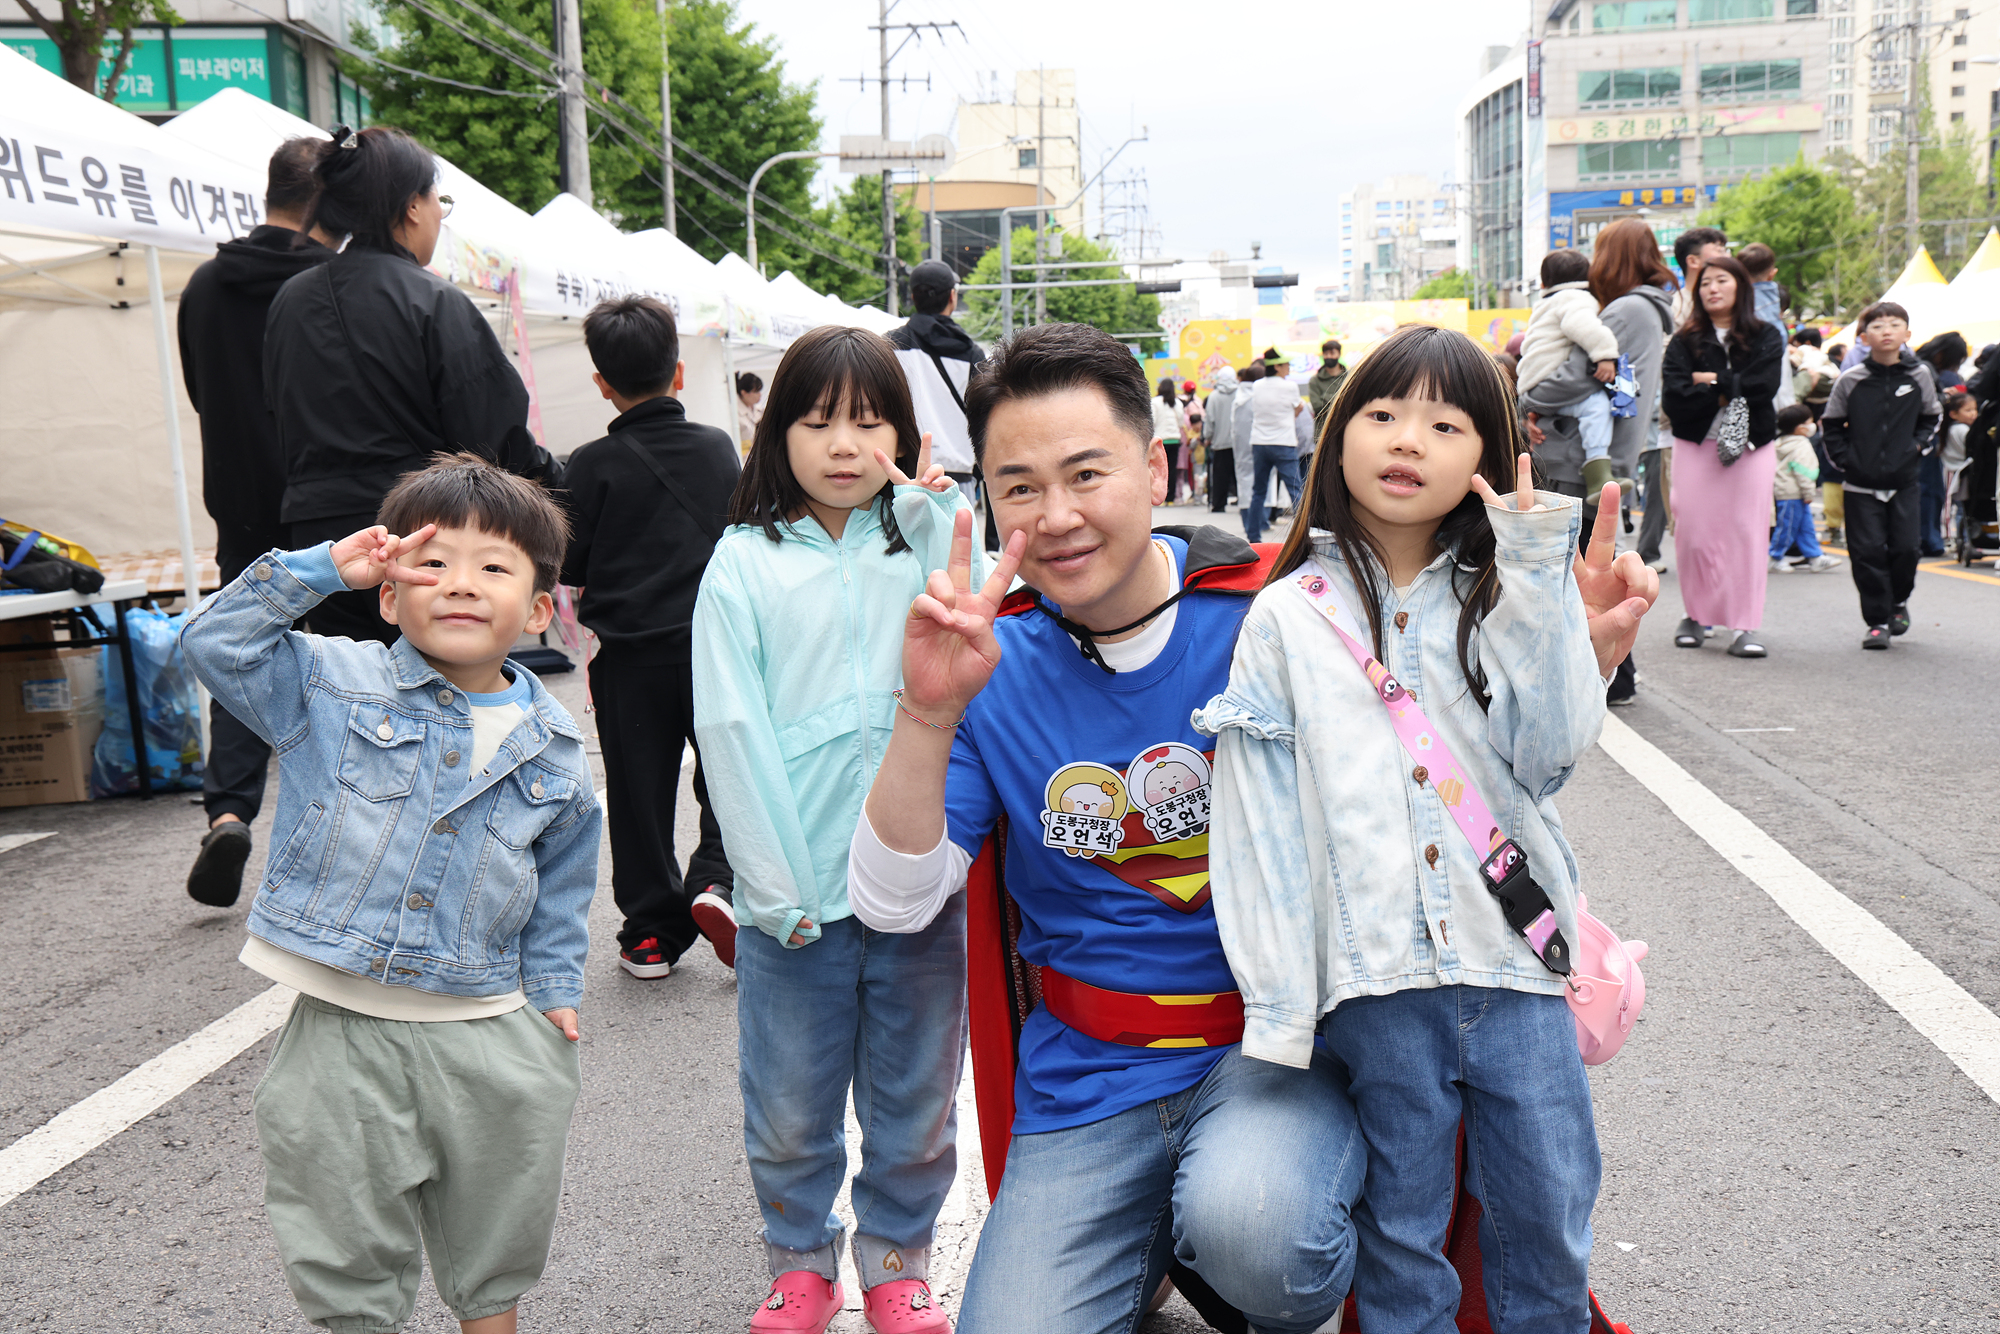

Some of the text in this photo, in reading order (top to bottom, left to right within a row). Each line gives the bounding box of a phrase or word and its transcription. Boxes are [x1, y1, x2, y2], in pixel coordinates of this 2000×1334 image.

[178, 57, 265, 81] 피부레이저
[0, 136, 267, 240] 위드유를 이겨라
[1155, 788, 1207, 817] 도봉구청장
[1056, 815, 1111, 831] 도봉구청장
